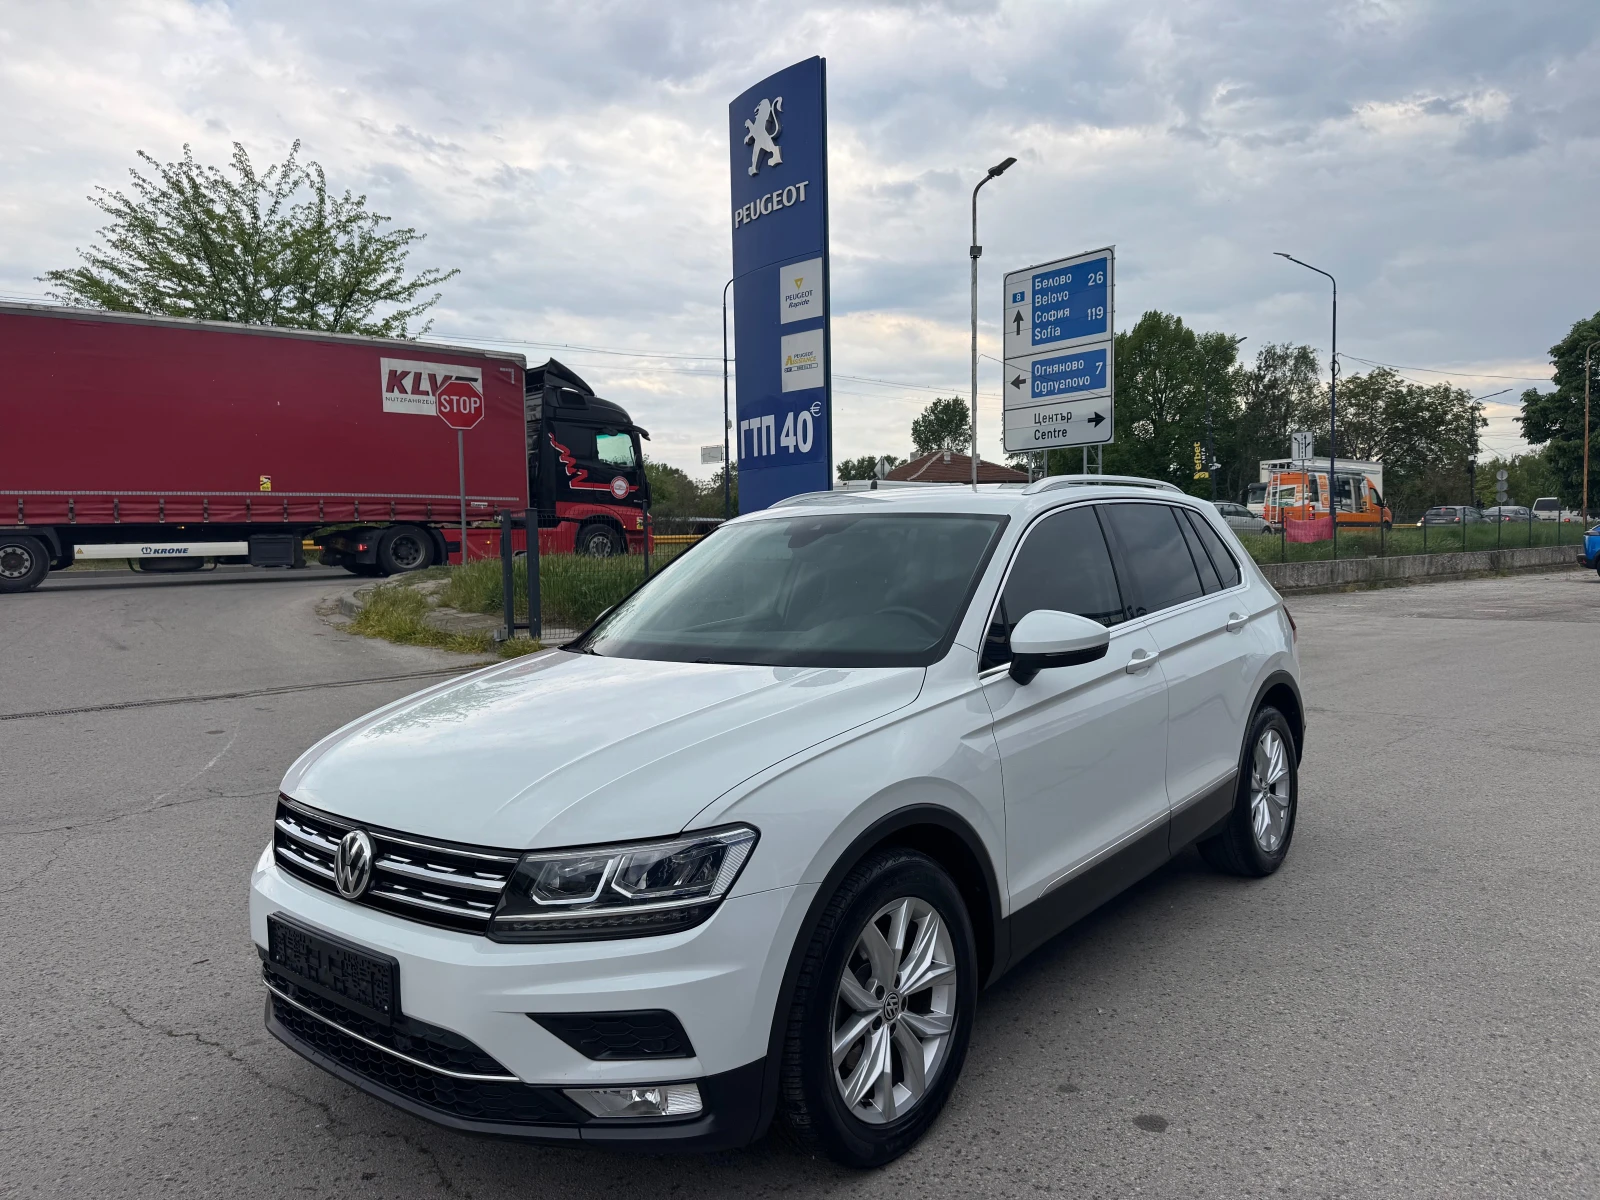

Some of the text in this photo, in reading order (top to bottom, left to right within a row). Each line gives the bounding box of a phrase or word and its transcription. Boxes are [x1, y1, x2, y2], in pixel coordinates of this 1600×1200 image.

[735, 181, 809, 229] PEUGEOT
[1035, 271, 1104, 290] Белово 26
[785, 290, 813, 302] PEUGEOT
[788, 299, 810, 309] Rapide
[1016, 293, 1021, 302] 8
[1035, 291, 1069, 307] Belovo
[1035, 306, 1104, 323] София 119
[1034, 325, 1061, 340] Sofia
[1034, 360, 1103, 376] Огняново 7
[1034, 376, 1090, 394] Ognyanovo
[385, 396, 437, 406] NUTZFAHRZEU
[440, 395, 480, 414] STOP
[1034, 411, 1072, 425] Център
[740, 414, 776, 460] ГТП
[1034, 428, 1068, 441] Centre
[1193, 441, 1202, 470] efbet
